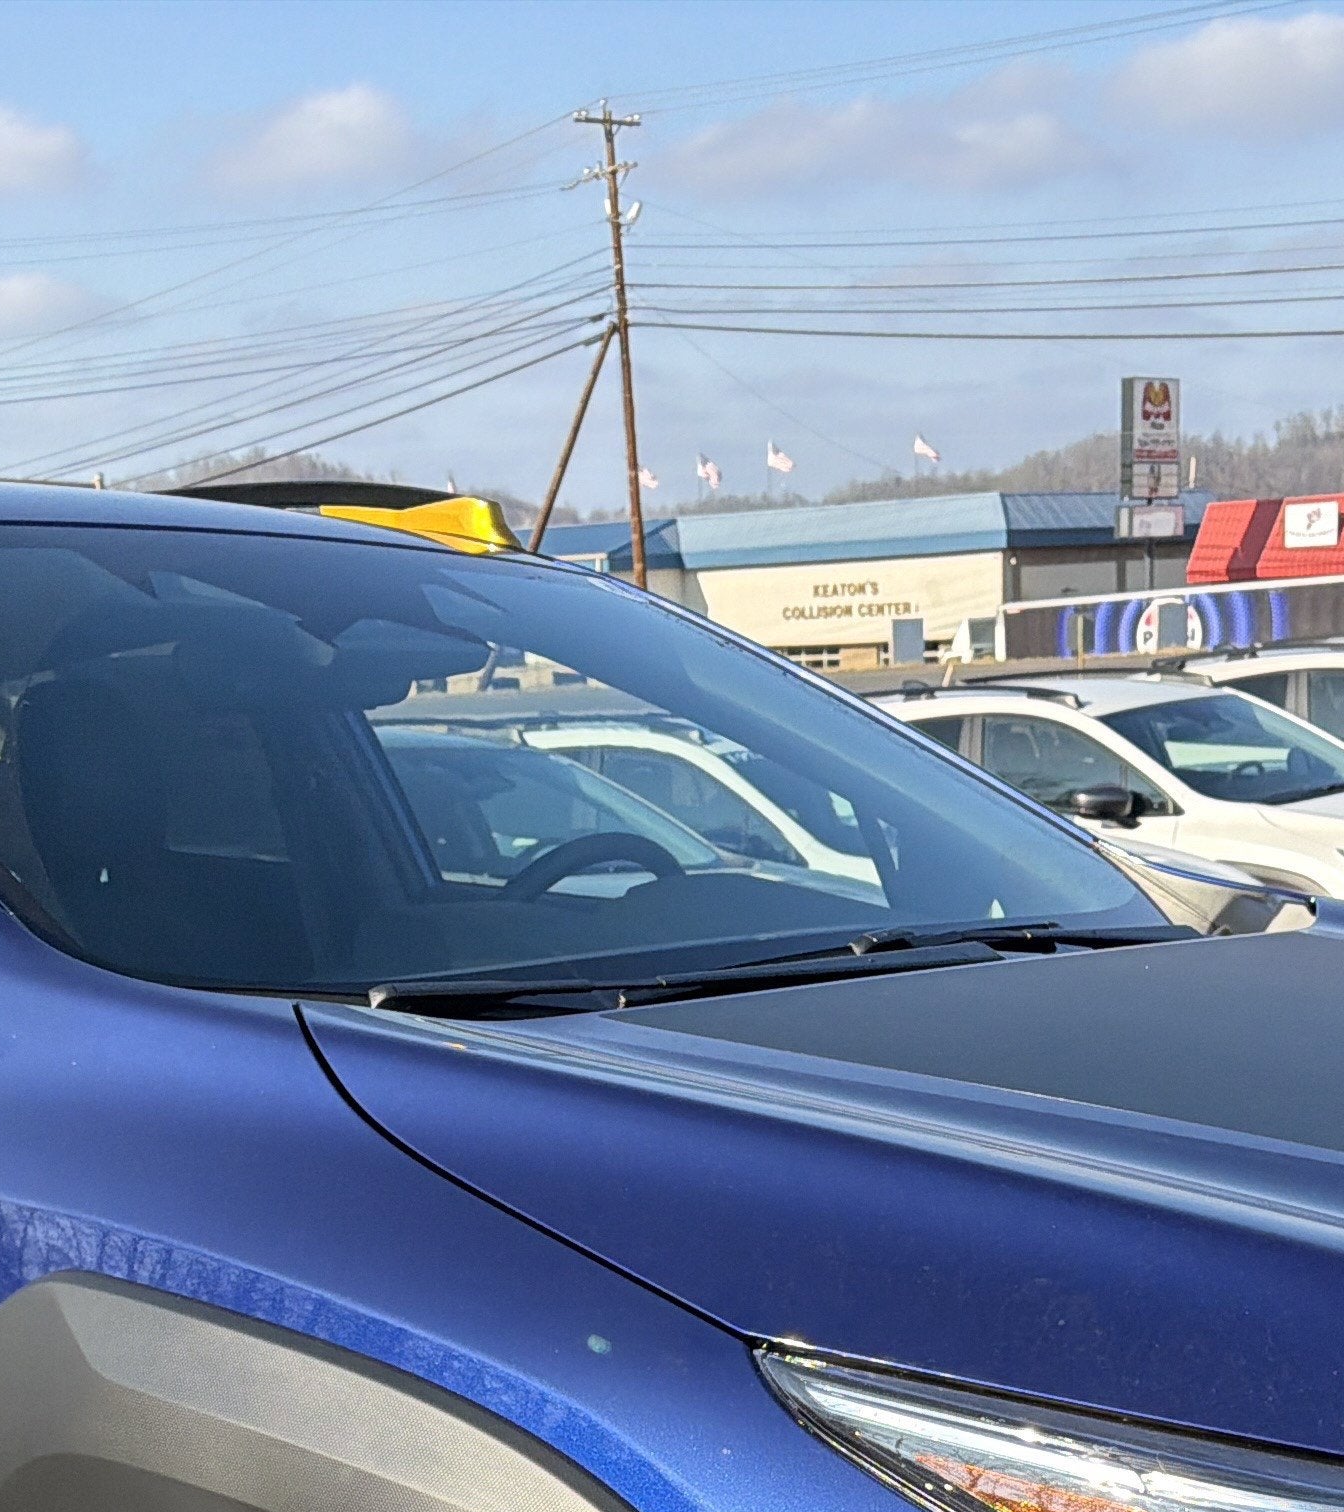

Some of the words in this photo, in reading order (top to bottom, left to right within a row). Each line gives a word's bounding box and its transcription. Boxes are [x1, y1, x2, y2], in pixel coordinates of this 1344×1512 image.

[812, 581, 879, 597] KEATON'S
[782, 604, 853, 620] COLLISION
[858, 602, 912, 617] CENTER
